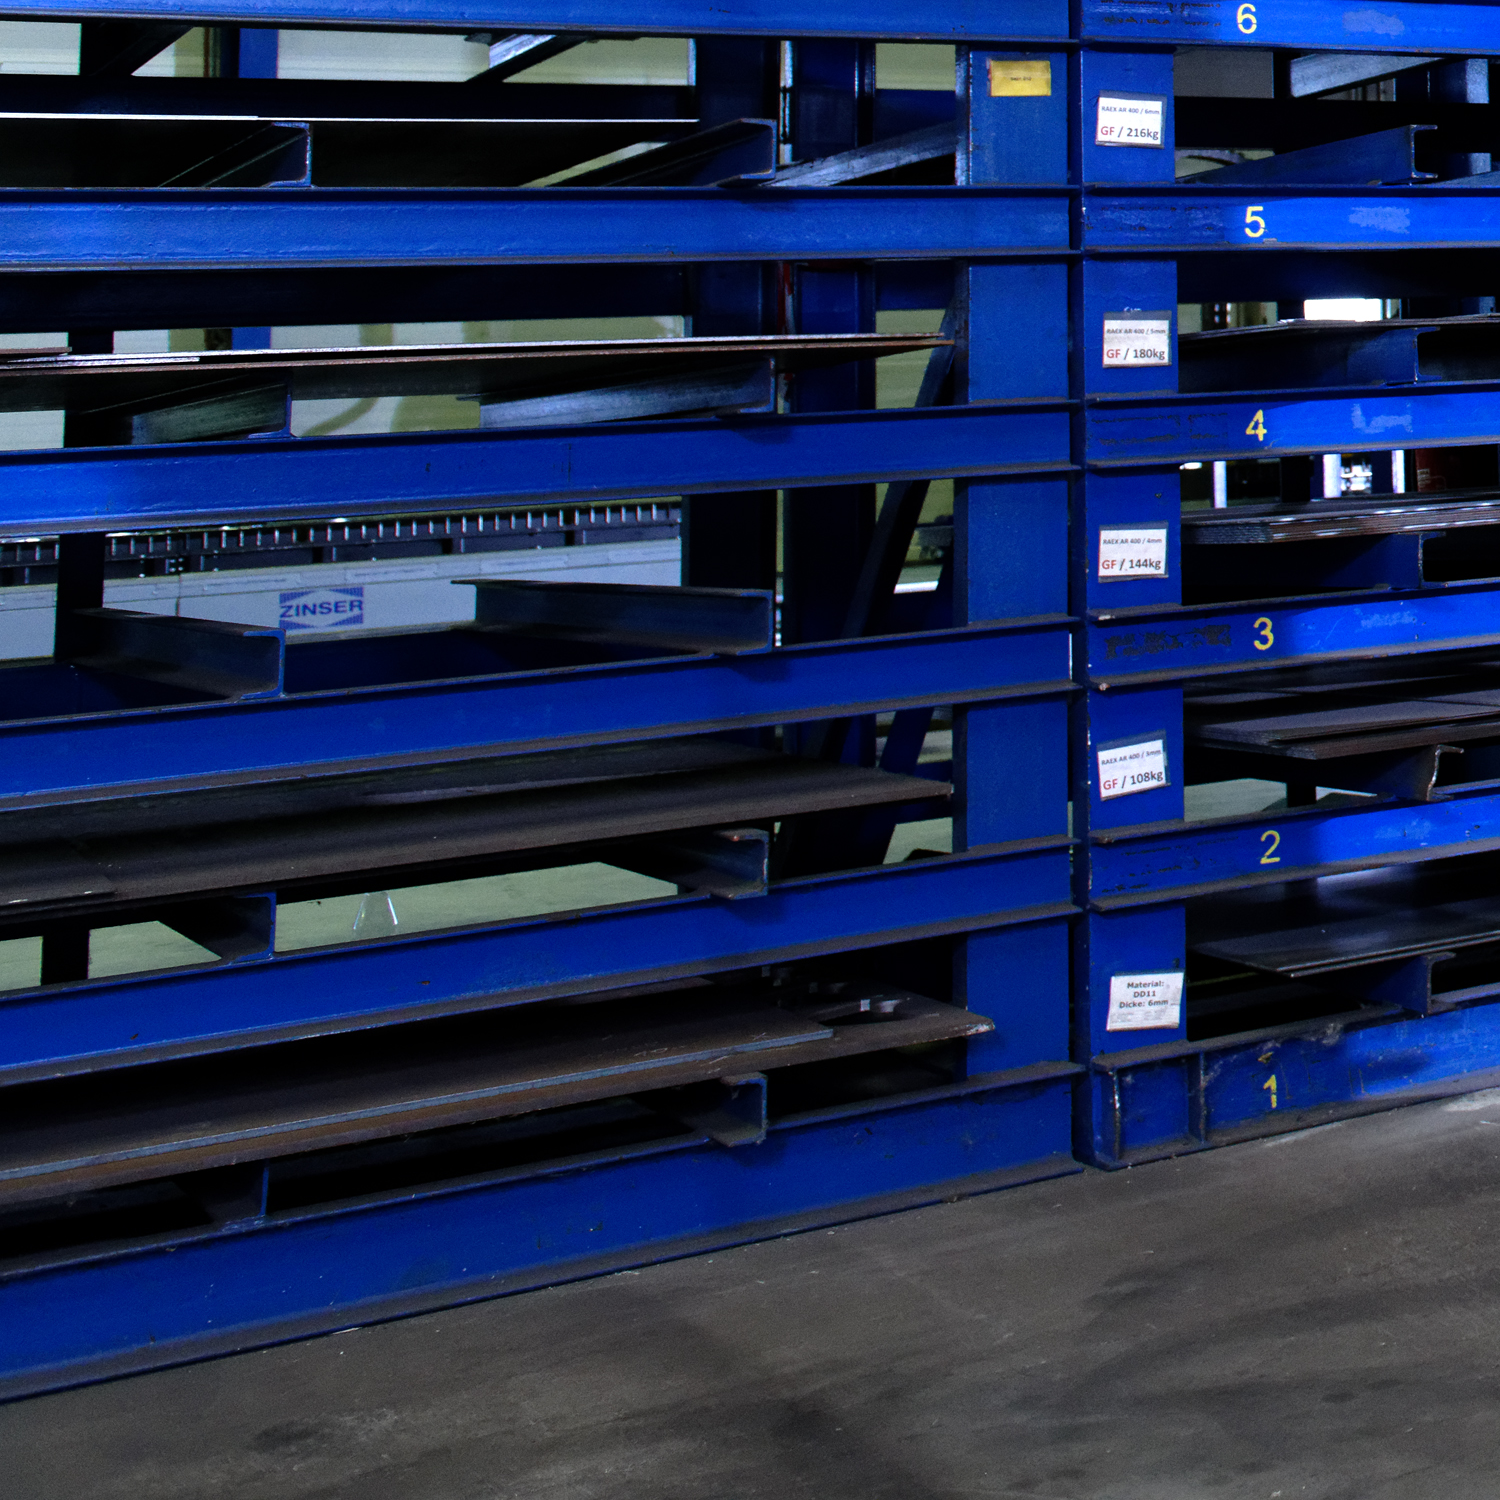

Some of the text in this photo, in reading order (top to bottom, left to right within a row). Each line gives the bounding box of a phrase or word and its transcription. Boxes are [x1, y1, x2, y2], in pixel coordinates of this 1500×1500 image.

[1236, 3, 1258, 35] 6
[1100, 126, 1115, 136] GF
[1126, 127, 1159, 141] 216kg
[1244, 205, 1266, 238] 5
[1106, 349, 1121, 359] GF
[1133, 348, 1165, 361] 180kg
[1246, 409, 1268, 442] 4
[1102, 560, 1117, 570] GF
[1129, 558, 1161, 570] 144kg
[280, 599, 364, 618] ZINSER
[1253, 618, 1274, 651] 3
[1103, 778, 1118, 790] GF
[1130, 771, 1163, 785] 108kg
[1259, 830, 1281, 865] 2
[1127, 981, 1164, 989] Material:
[1133, 990, 1156, 998] DD11
[1119, 1001, 1145, 1009] Dicke:
[1263, 1074, 1277, 1109] 1
